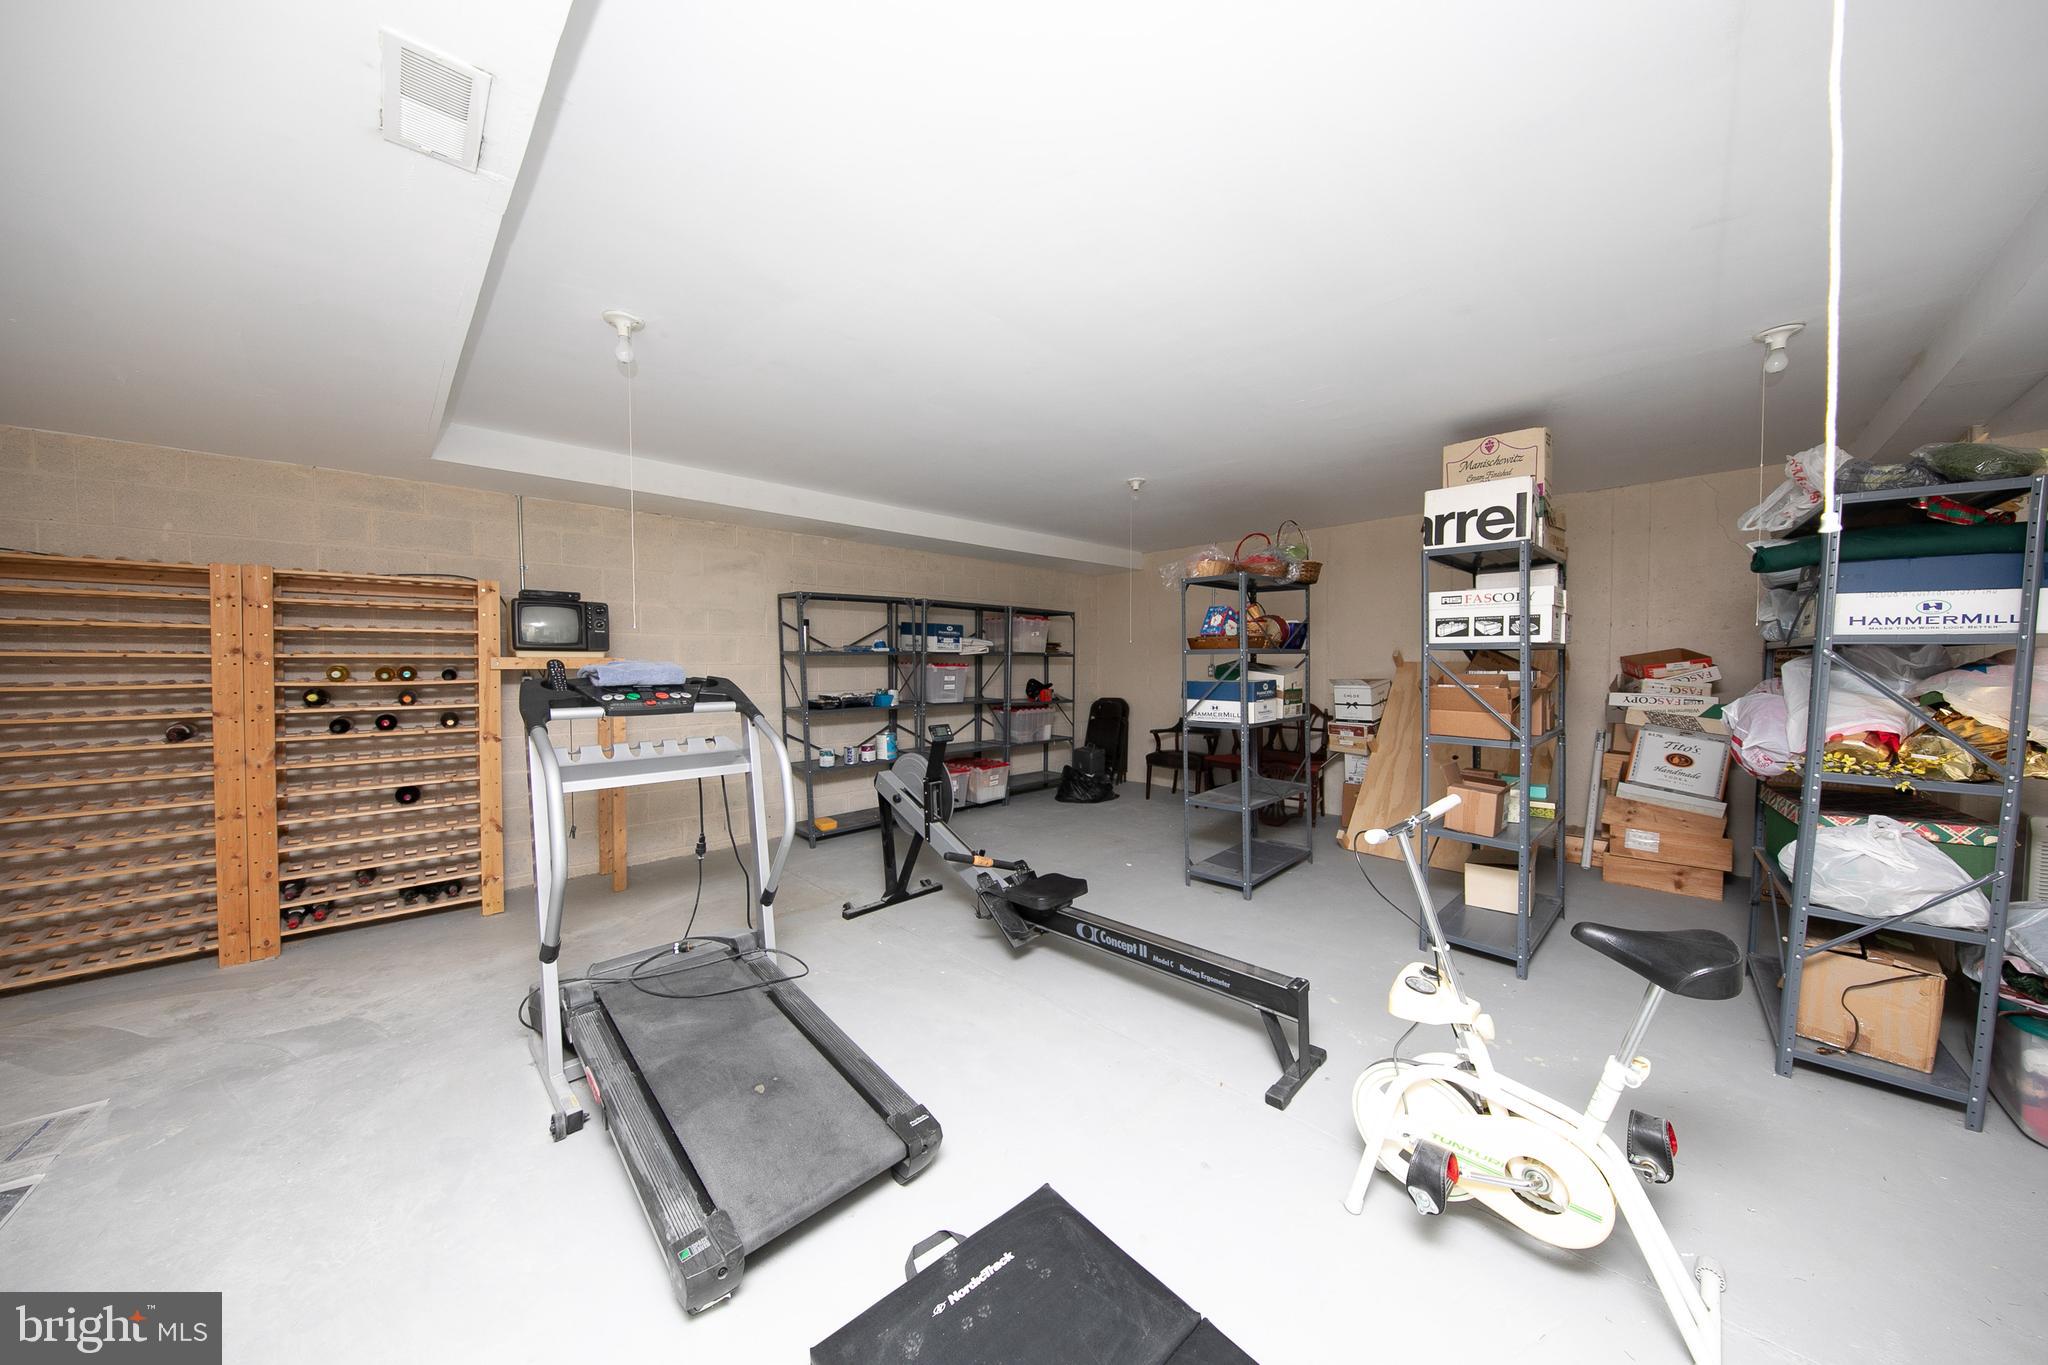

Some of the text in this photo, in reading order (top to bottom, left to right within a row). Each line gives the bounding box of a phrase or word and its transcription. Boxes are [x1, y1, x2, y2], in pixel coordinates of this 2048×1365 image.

[1459, 454, 1526, 472] Manischewitz
[1623, 696, 1681, 706] FASCOPY
[1664, 741, 1701, 754] Tito's
[1654, 765, 1702, 779] Handmade
[1100, 930, 1137, 955] Concept
[1152, 955, 1169, 967] Model
[1179, 964, 1200, 979] Rowing
[1200, 971, 1231, 989] Ergometer
[947, 1251, 1015, 1305] NordicTrack
